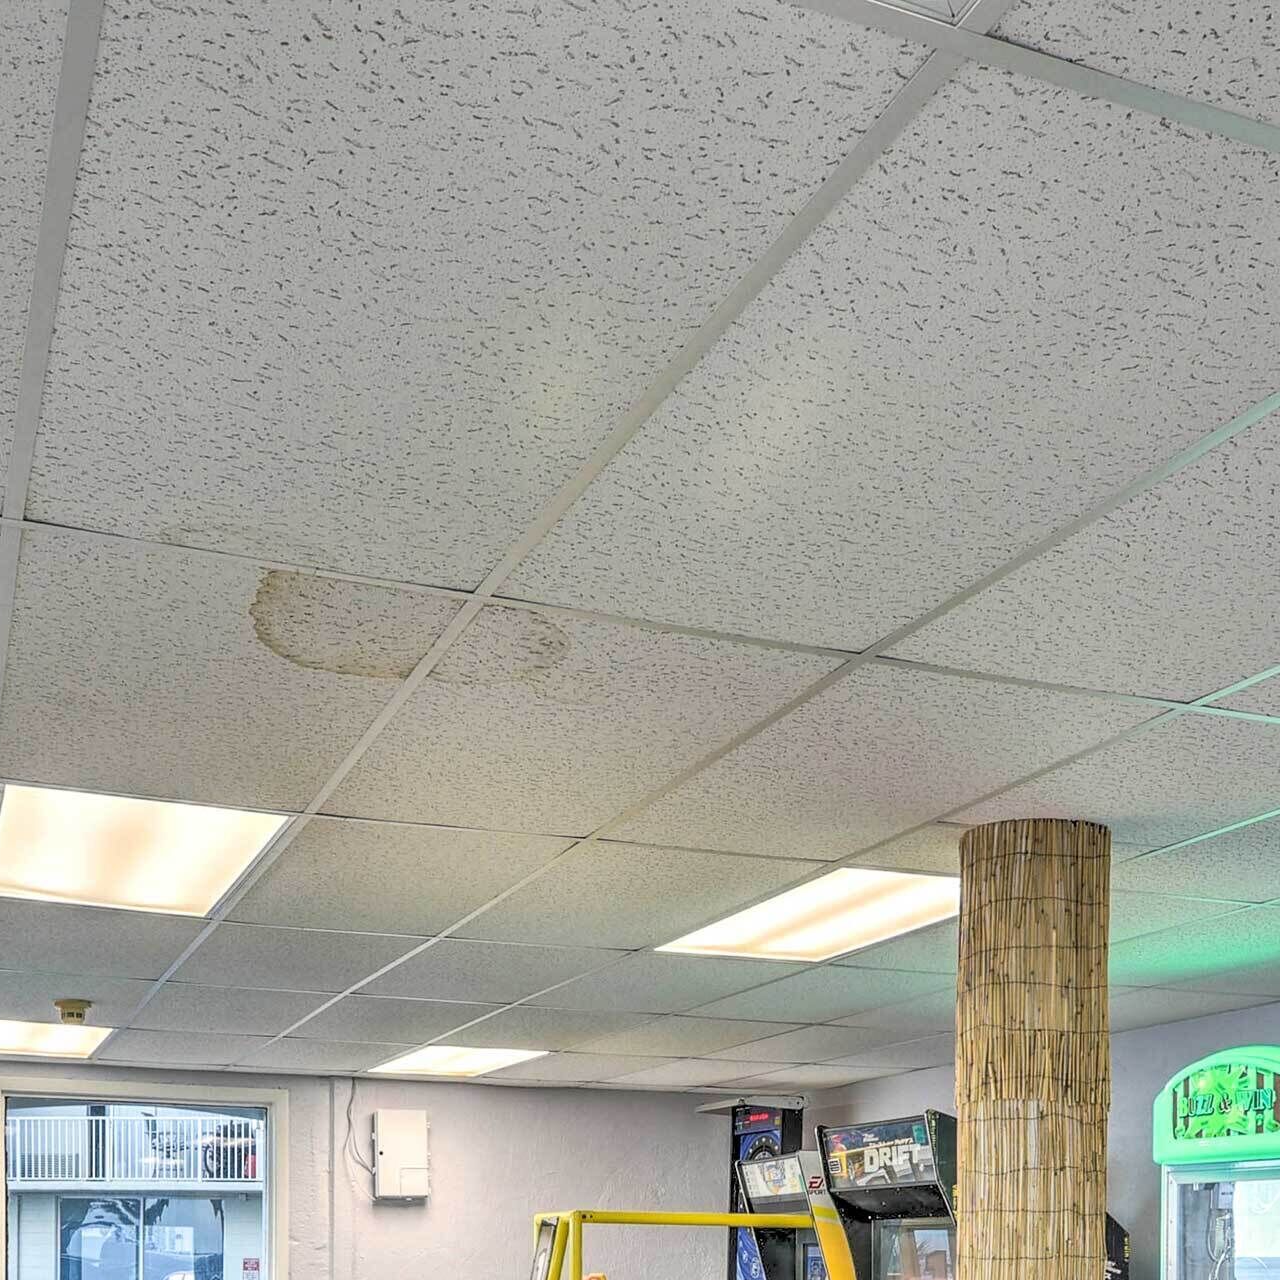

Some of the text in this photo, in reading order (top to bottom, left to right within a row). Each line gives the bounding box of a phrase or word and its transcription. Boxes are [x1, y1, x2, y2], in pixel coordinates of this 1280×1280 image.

[1180, 1087, 1274, 1117] BUZZ & WIN
[864, 1143, 921, 1174] DRIFT
